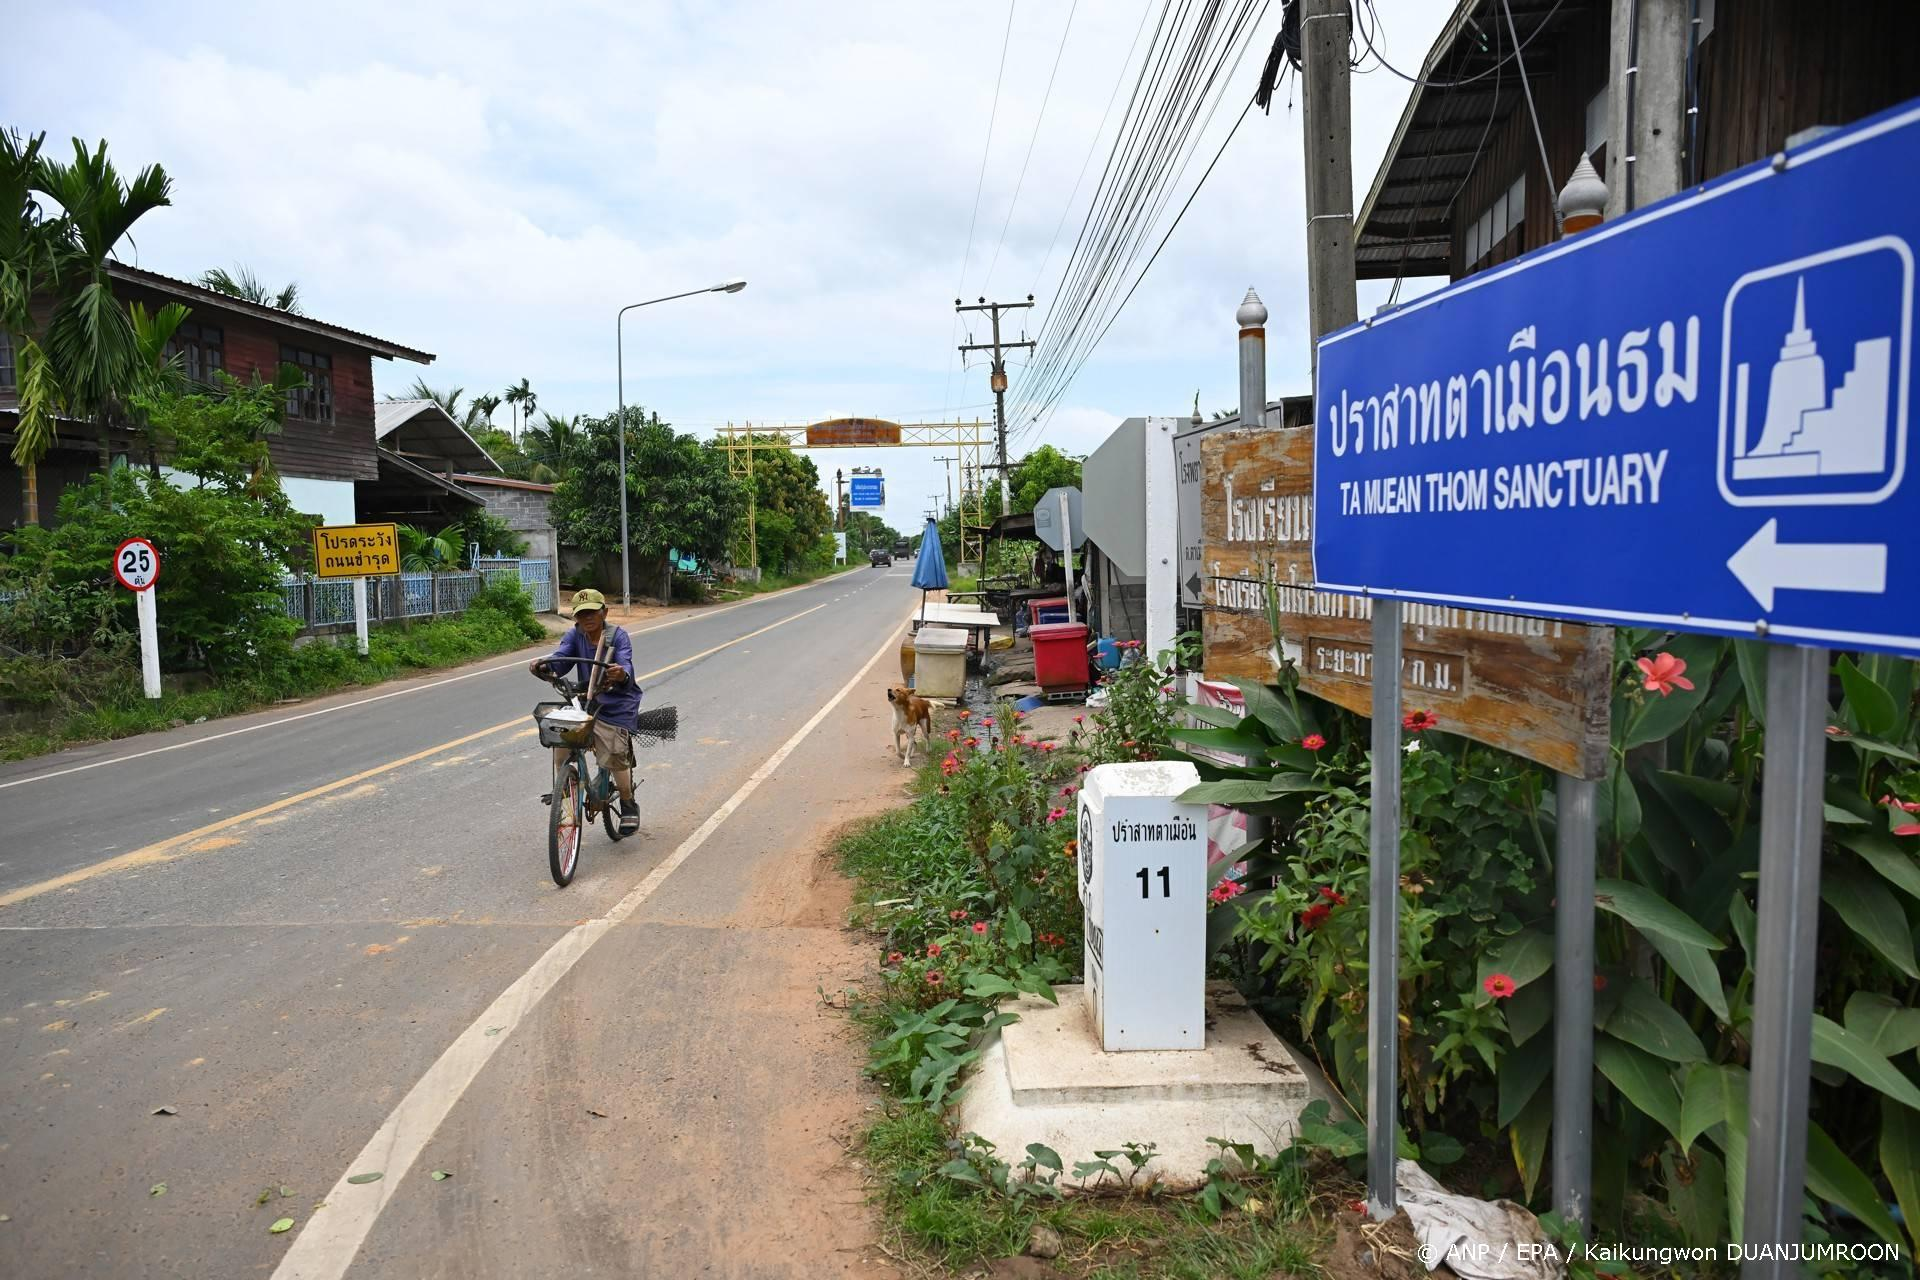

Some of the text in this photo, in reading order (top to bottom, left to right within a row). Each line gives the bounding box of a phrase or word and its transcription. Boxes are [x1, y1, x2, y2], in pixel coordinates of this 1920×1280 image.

[1329, 315, 1700, 457] ปราสาทตาเมือนธม
[1340, 449, 1669, 515] TA MUEAN THOM SANCTUARY
[320, 532, 392, 549] โปรดระวัง
[122, 550, 150, 573] 25
[325, 551, 390, 570] ถนนชำรุด
[1112, 815, 1197, 843] ปราสาทตาเมือน
[1135, 866, 1170, 899] 11
